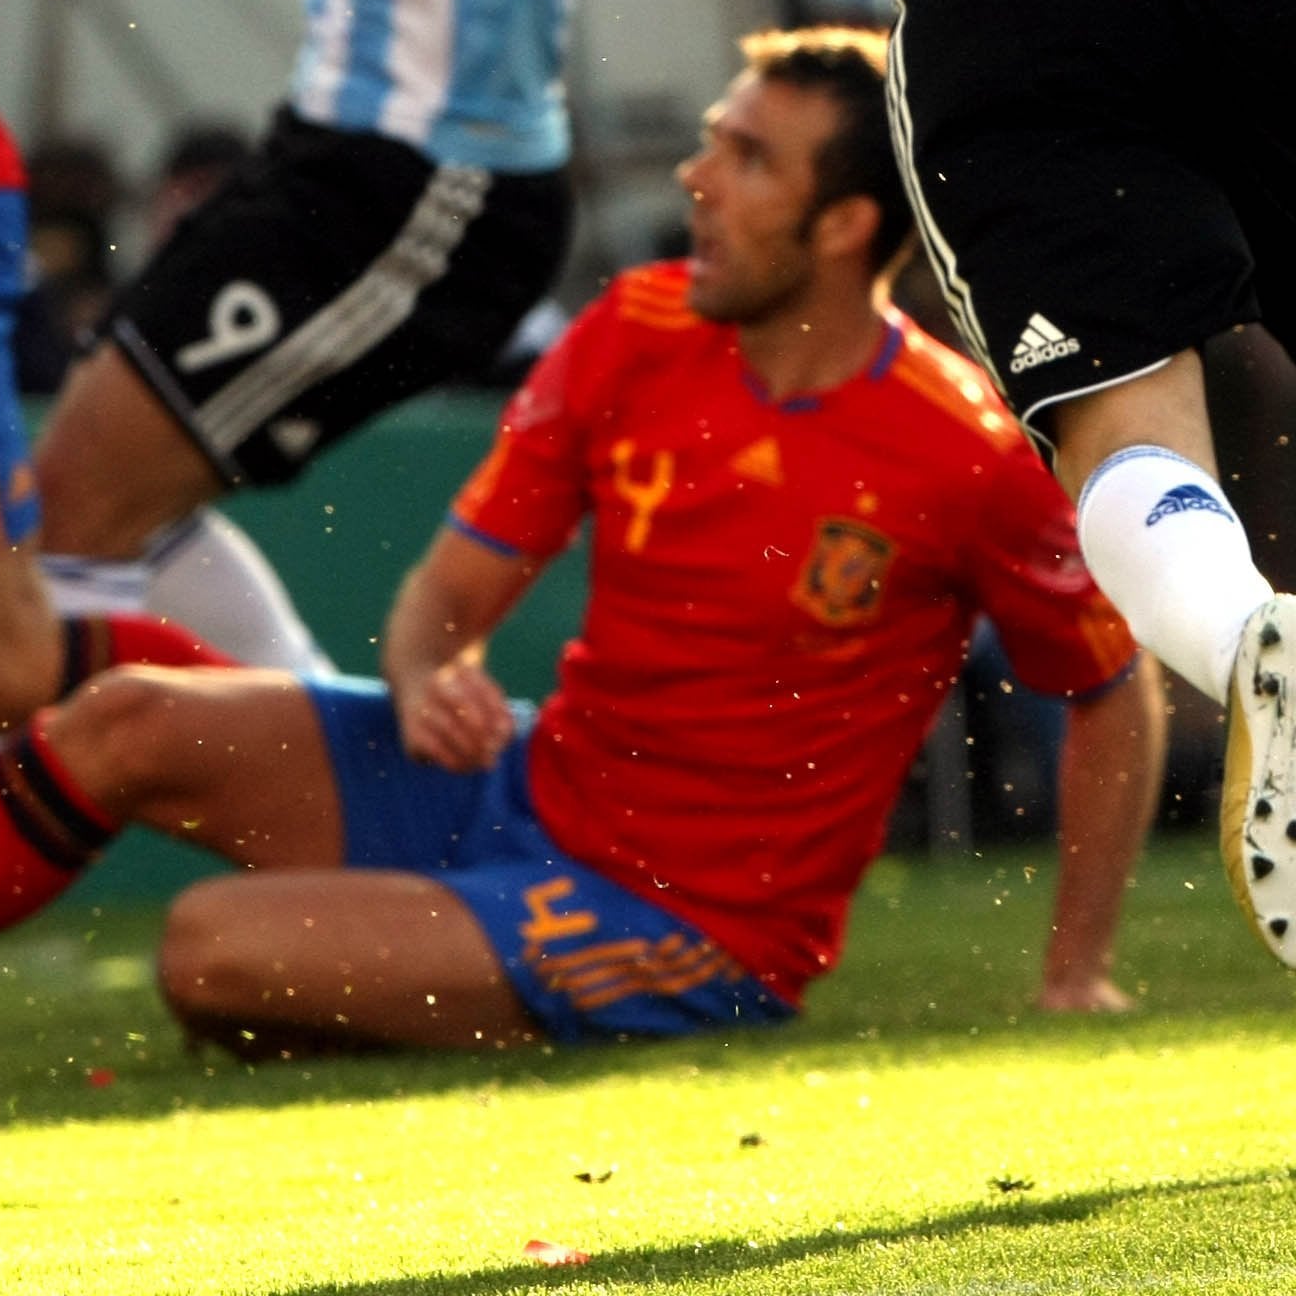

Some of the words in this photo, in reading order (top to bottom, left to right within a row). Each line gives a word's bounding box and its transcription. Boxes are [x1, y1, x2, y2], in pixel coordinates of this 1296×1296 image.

[177, 280, 281, 372] 9
[1010, 337, 1081, 374] adidas
[610, 439, 674, 553] 4
[520, 876, 597, 961] 4
